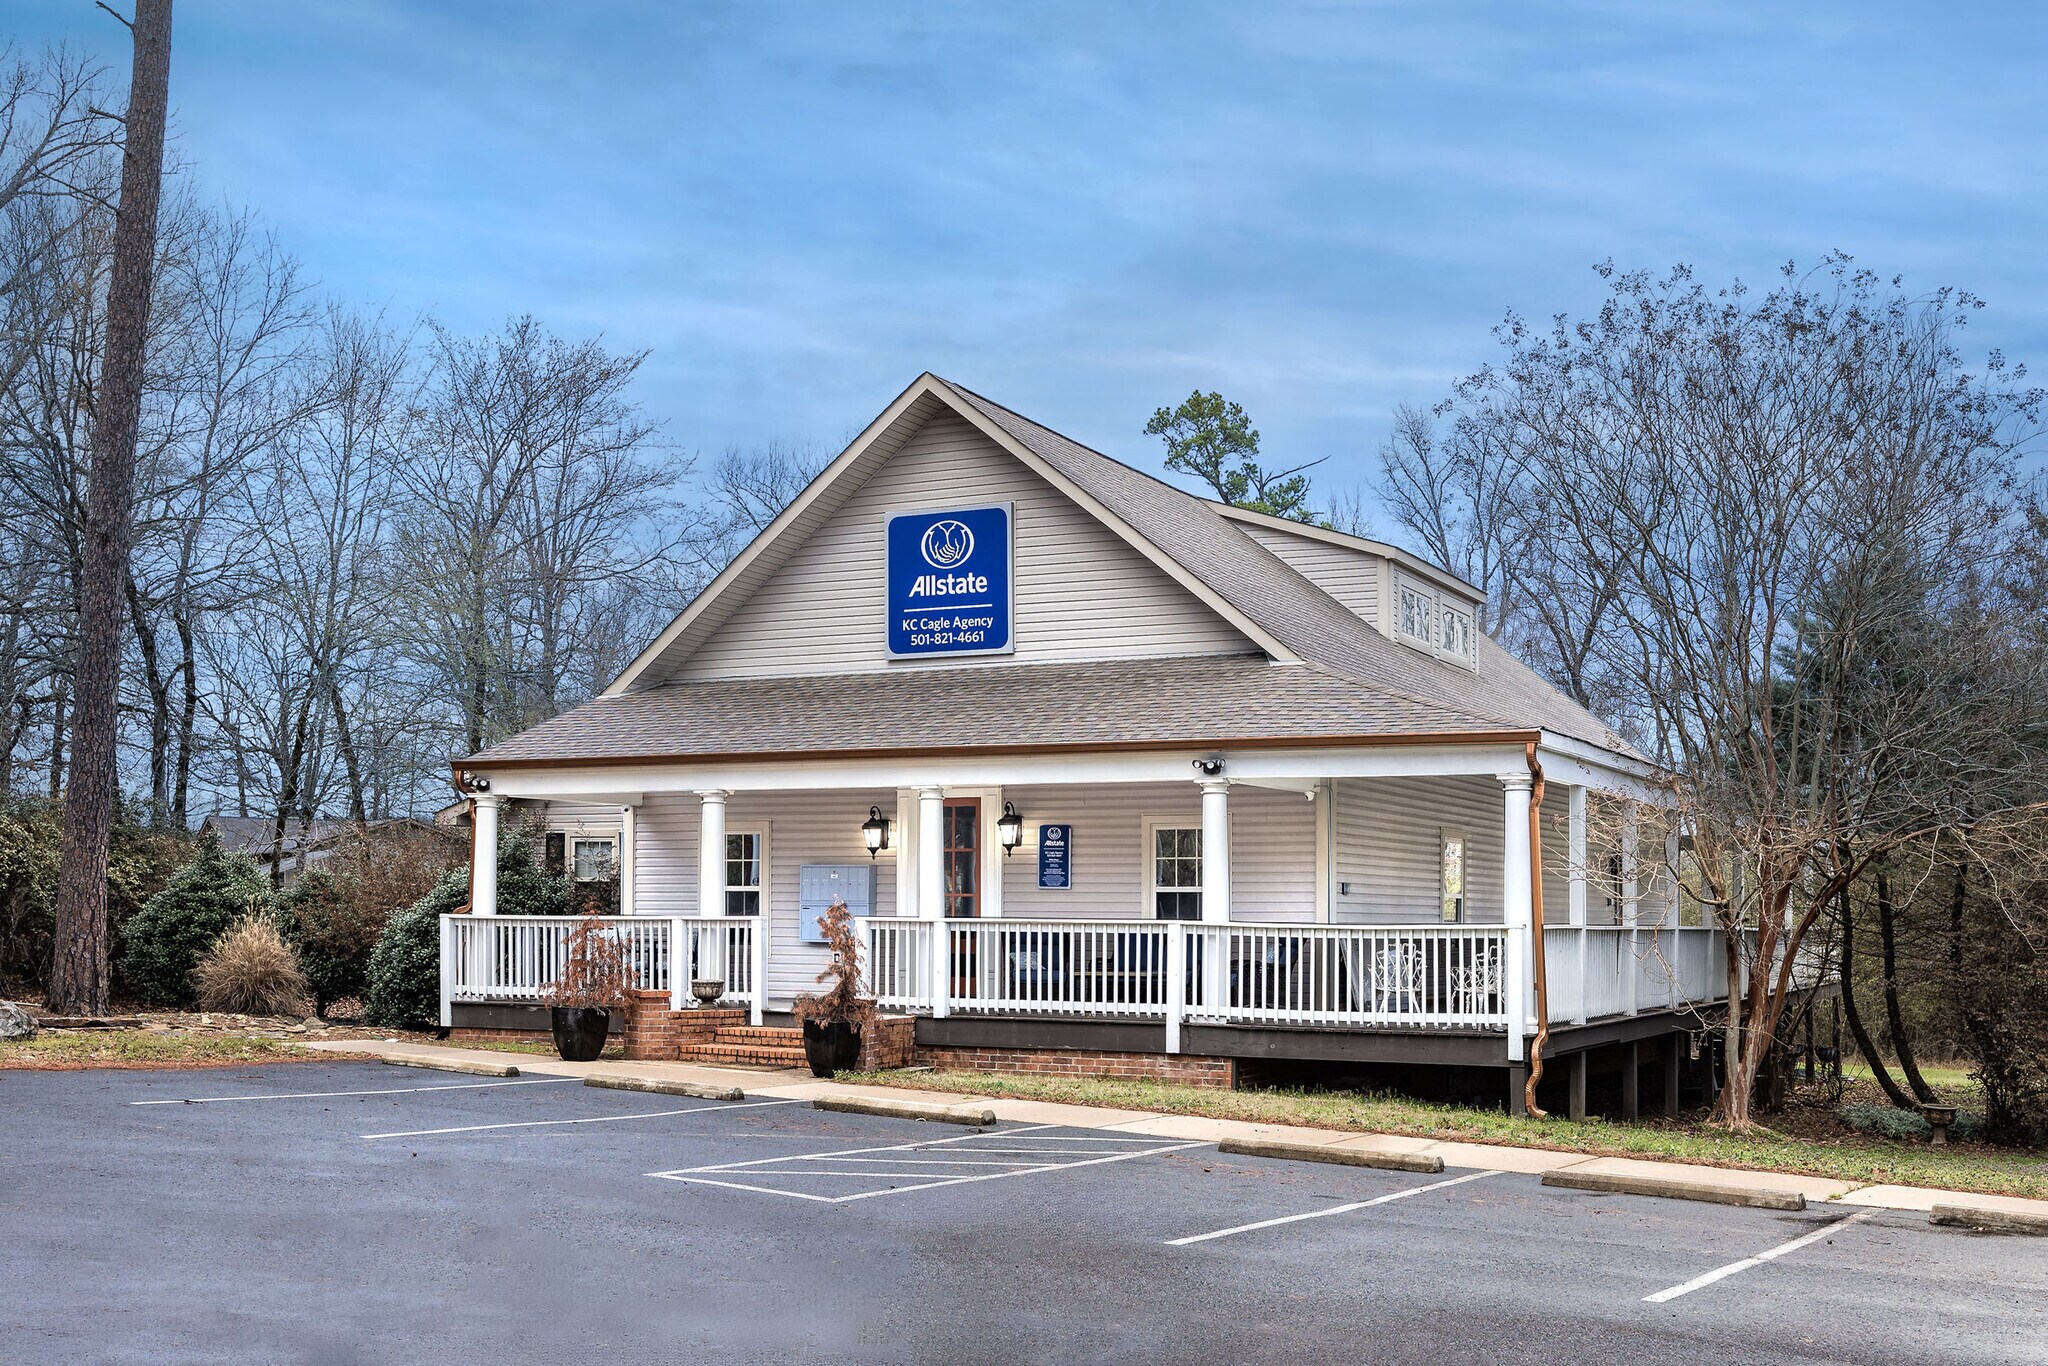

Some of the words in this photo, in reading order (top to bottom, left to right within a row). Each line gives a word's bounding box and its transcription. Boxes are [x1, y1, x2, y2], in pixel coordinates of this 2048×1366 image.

[908, 572, 988, 598] Allstate
[902, 618, 918, 631] KC
[920, 617, 950, 631] Cagle
[953, 616, 993, 630] Agency
[910, 630, 984, 646] 501-821-4661
